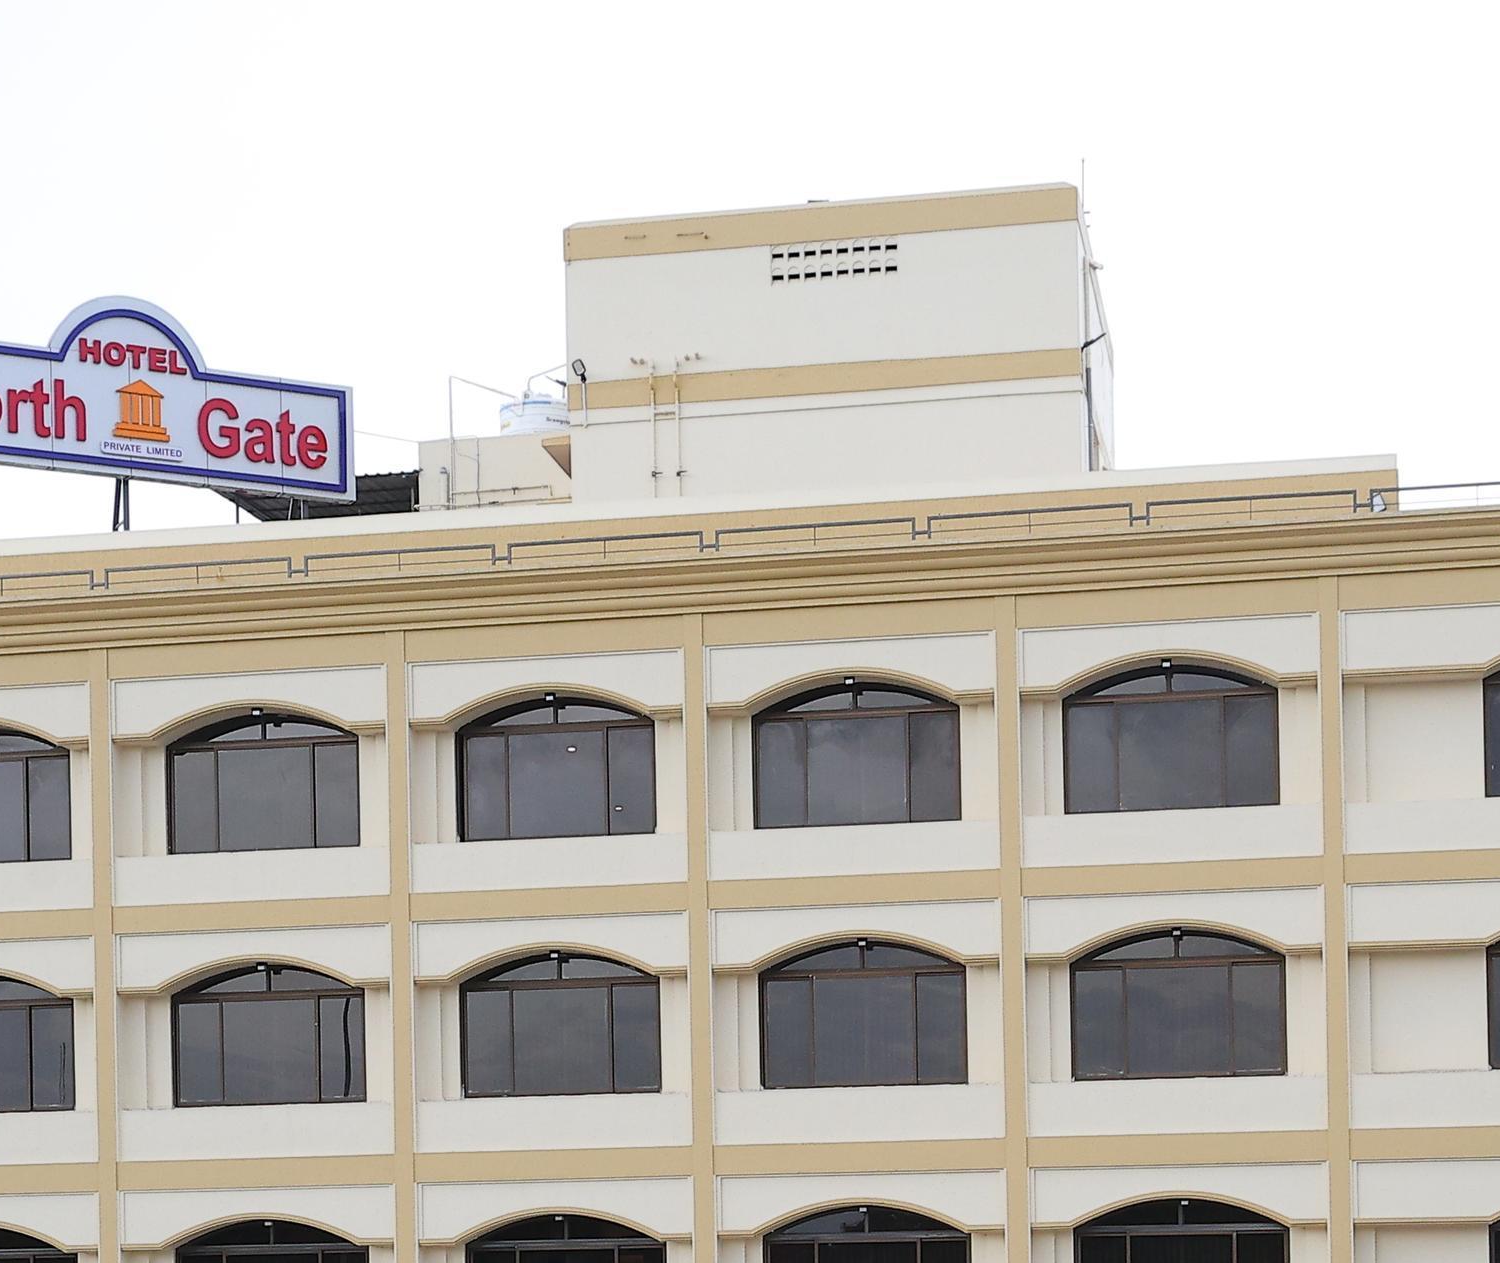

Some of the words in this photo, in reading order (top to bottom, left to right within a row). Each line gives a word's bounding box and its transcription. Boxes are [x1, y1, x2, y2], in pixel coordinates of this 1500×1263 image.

[78, 337, 188, 376] HOTEL
[103, 441, 142, 453] PRIVATE
[146, 446, 183, 457] LIMITED
[198, 397, 328, 470] Gate
